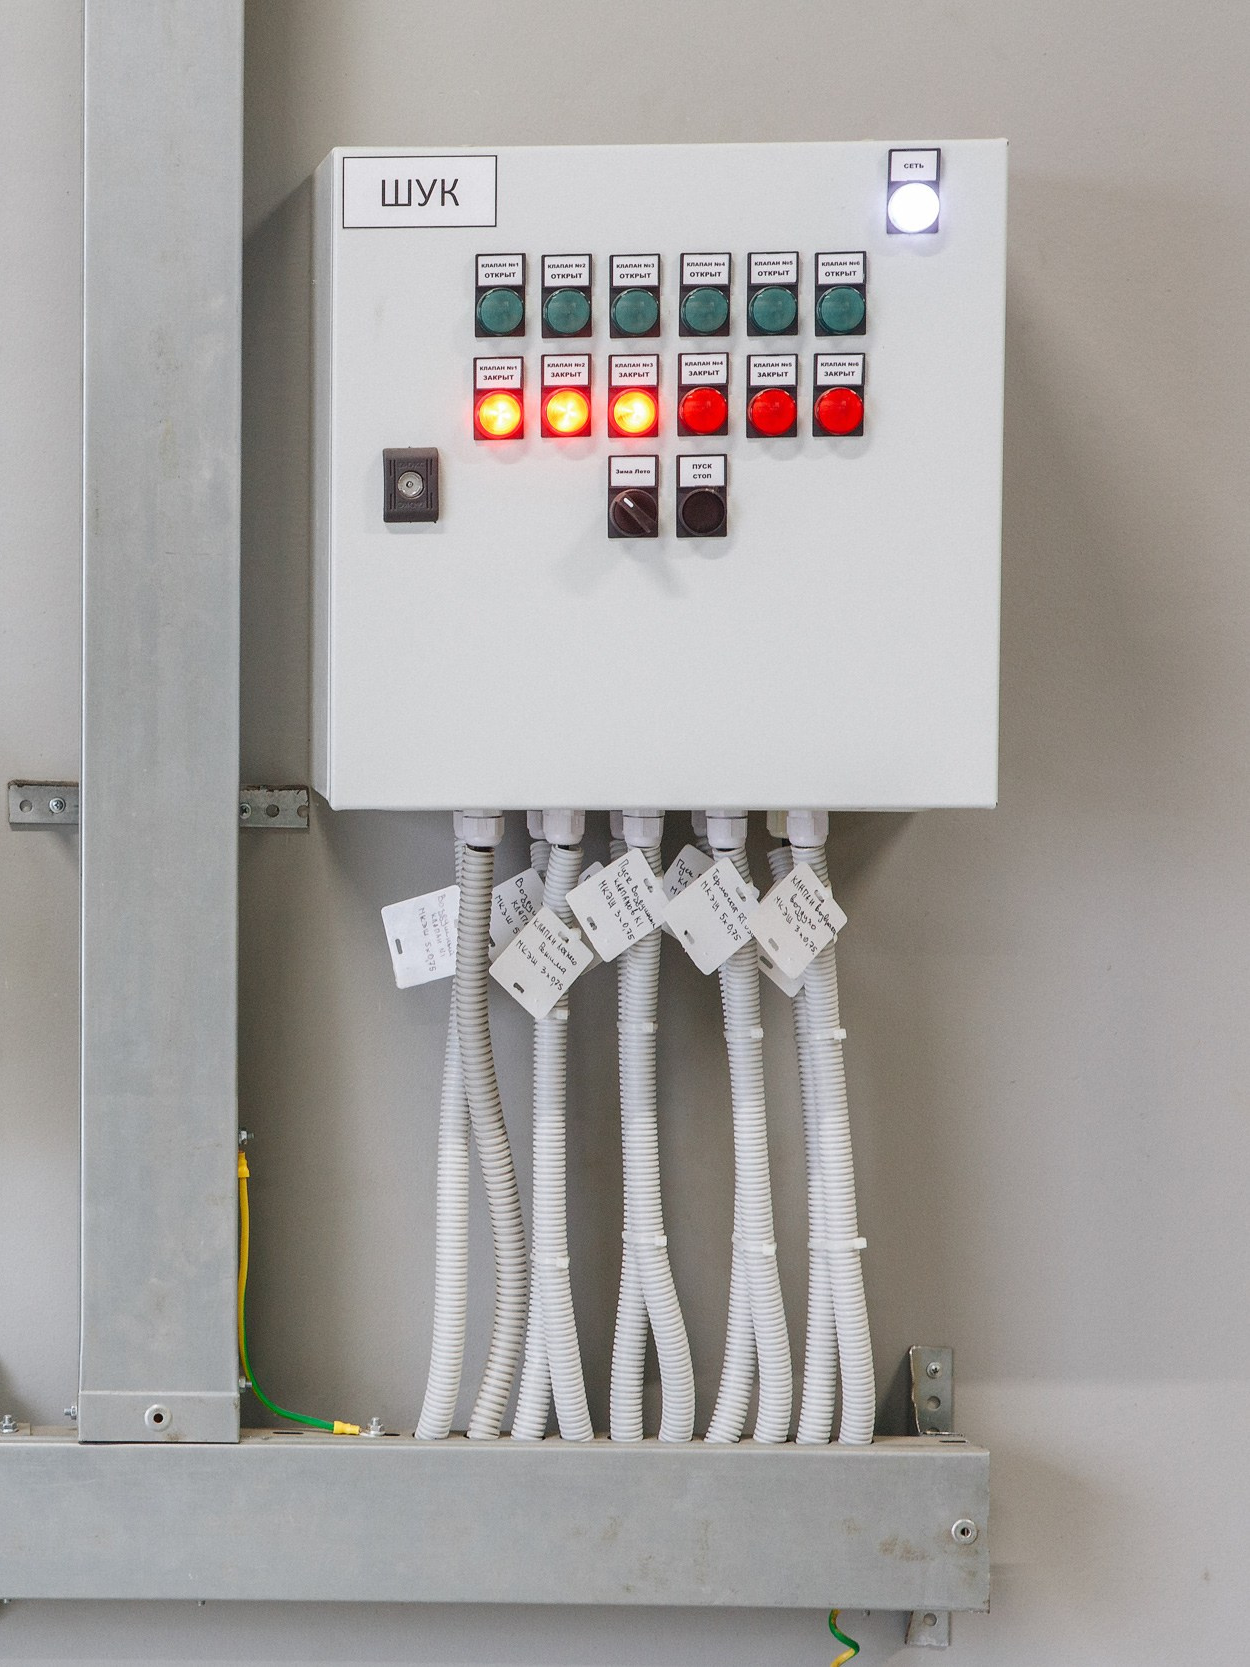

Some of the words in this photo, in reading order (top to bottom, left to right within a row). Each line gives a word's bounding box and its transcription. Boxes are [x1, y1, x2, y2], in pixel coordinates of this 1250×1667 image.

[381, 179, 459, 207] ШУК
[485, 271, 516, 279] ОТКРЫТ
[551, 272, 582, 280] ОТКРЫТ
[689, 369, 719, 377] ЗАКРЫТ
